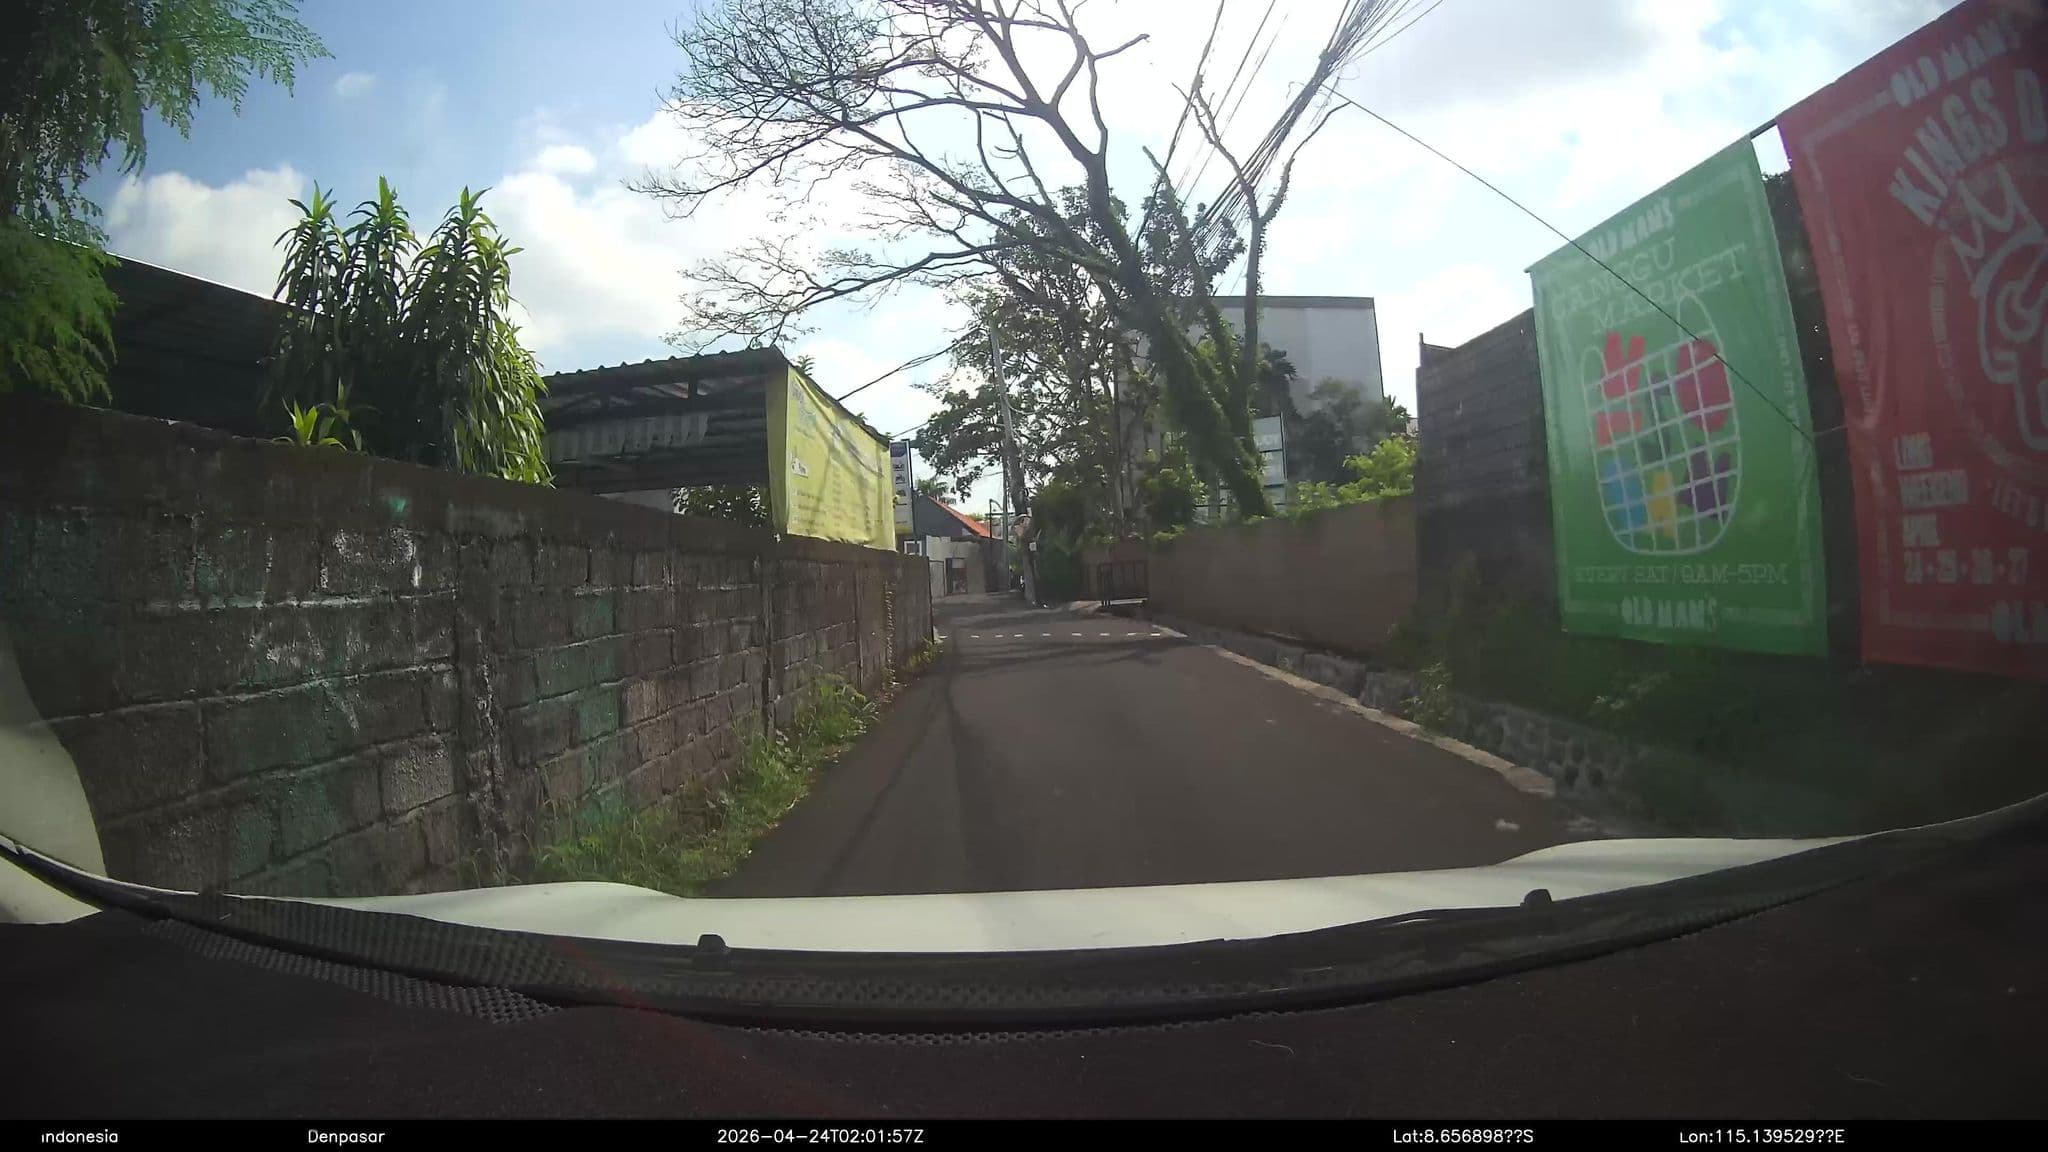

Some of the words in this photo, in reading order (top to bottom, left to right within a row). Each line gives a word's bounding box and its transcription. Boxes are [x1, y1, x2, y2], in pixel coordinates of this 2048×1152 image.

[1888, 75, 2010, 229] KINGS
[1551, 235, 1676, 322] CANGGU
[1591, 241, 1747, 337] MARKET
[1621, 595, 1653, 625] OLD
[1656, 590, 1718, 633] MAN'S
